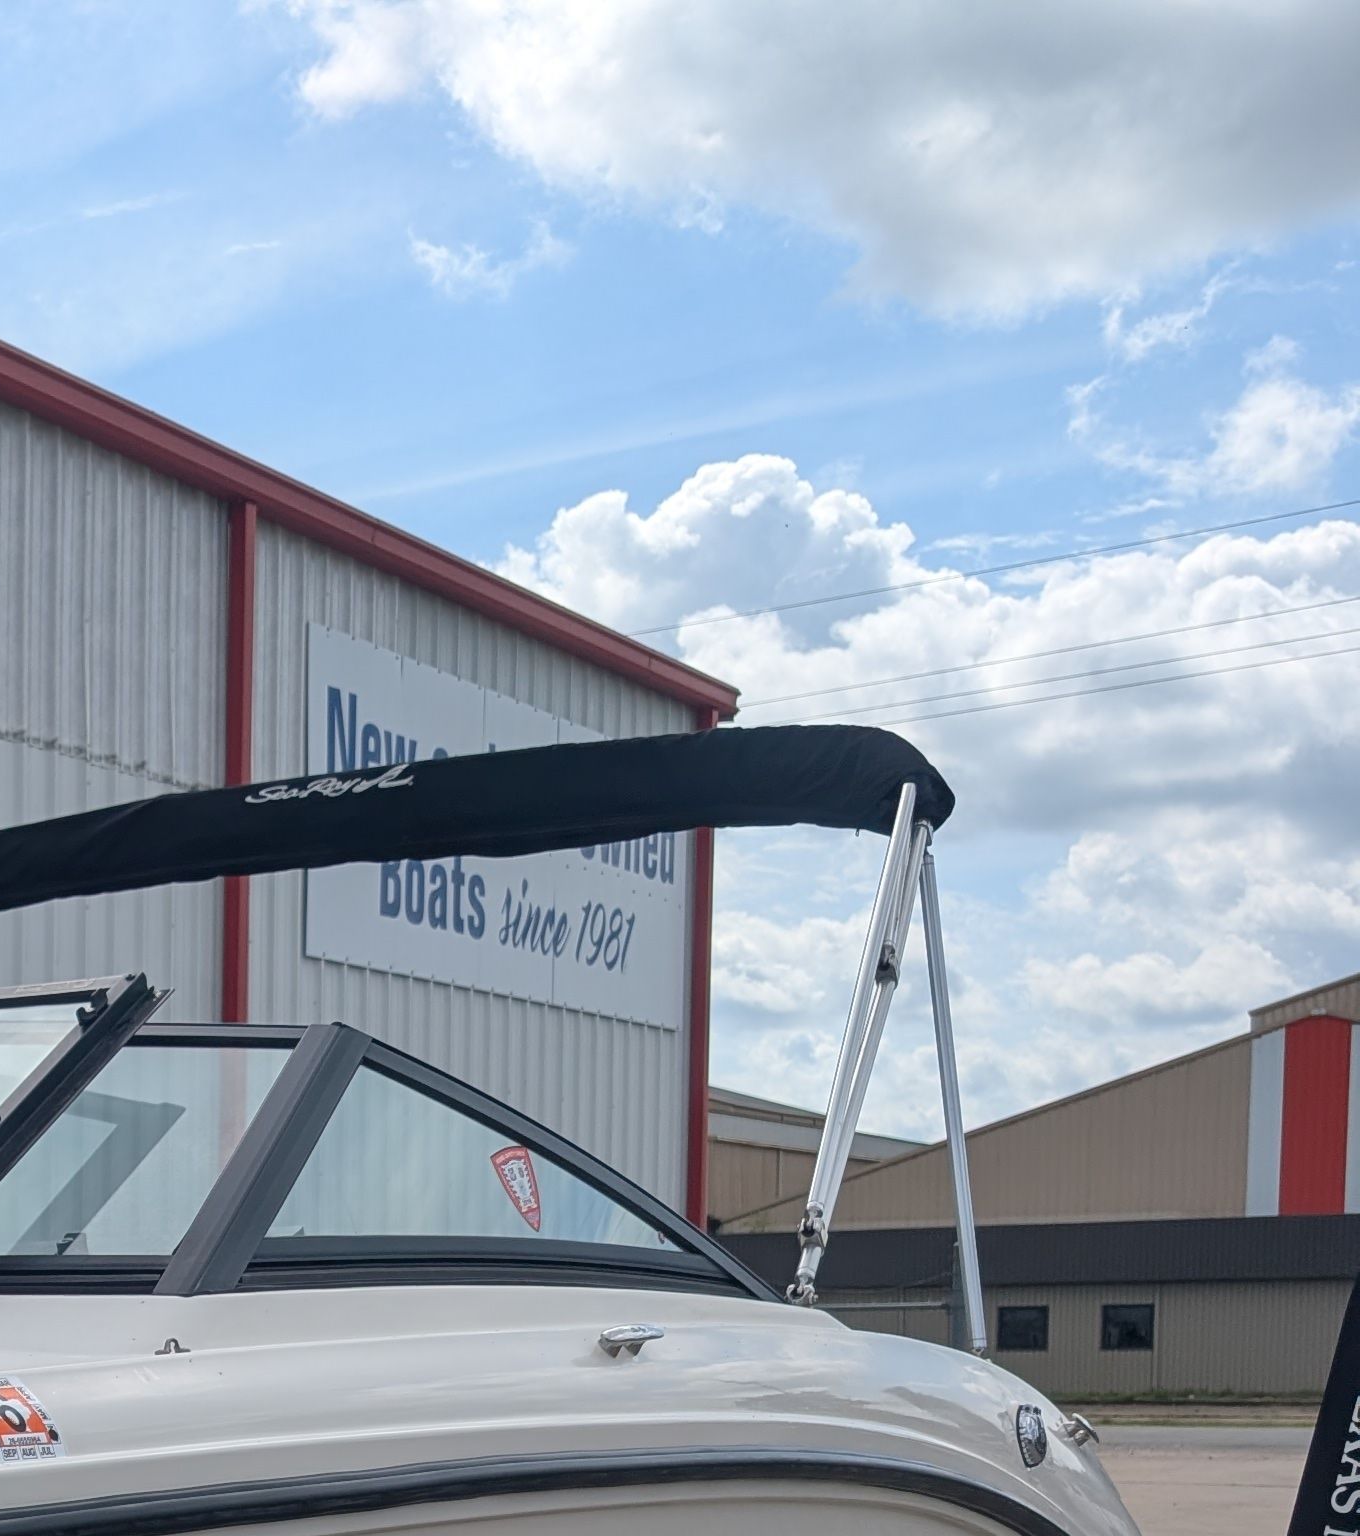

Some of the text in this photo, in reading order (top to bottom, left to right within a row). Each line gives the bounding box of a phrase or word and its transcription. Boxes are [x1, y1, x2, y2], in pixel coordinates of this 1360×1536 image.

[379, 856, 635, 974] Boats since 1981
